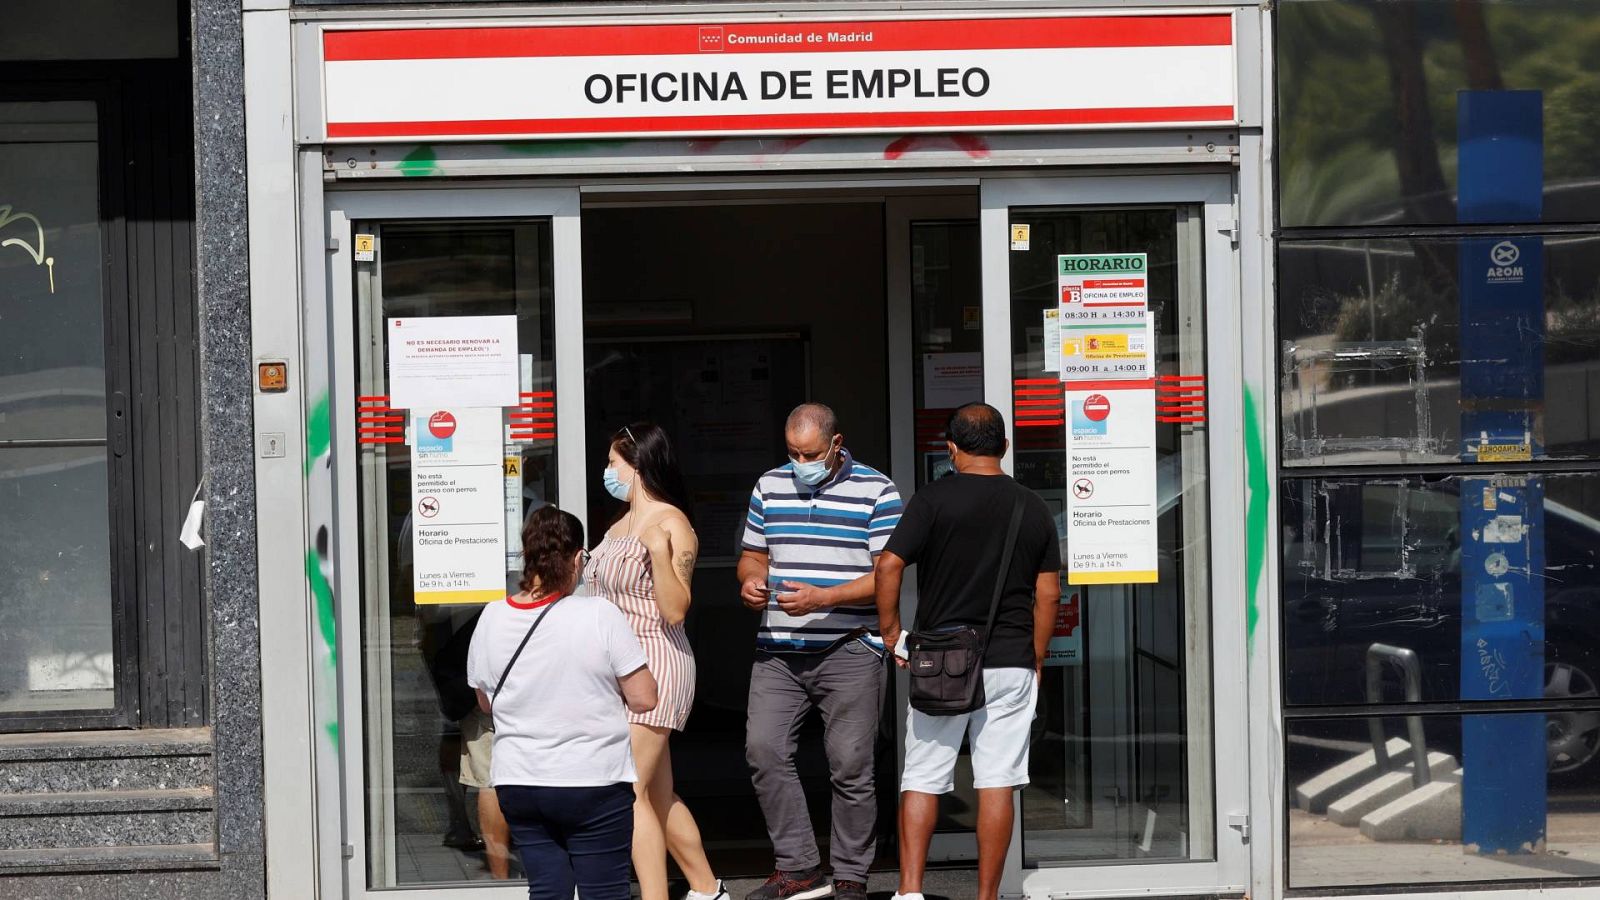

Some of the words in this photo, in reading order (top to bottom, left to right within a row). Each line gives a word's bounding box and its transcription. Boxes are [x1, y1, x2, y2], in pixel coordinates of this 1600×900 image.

[727, 32, 803, 45] Comunidad
[806, 32, 823, 44] de
[826, 31, 874, 43] Madrid
[583, 71, 748, 105] OFICINA
[760, 70, 813, 101] DE
[826, 67, 991, 100] EMPLEO
[1064, 257, 1143, 271] HORARIO
[1070, 291, 1081, 302] B
[1114, 364, 1137, 372] 14:00
[419, 538, 443, 546] Oficina
[454, 537, 498, 545] Prestaciones
